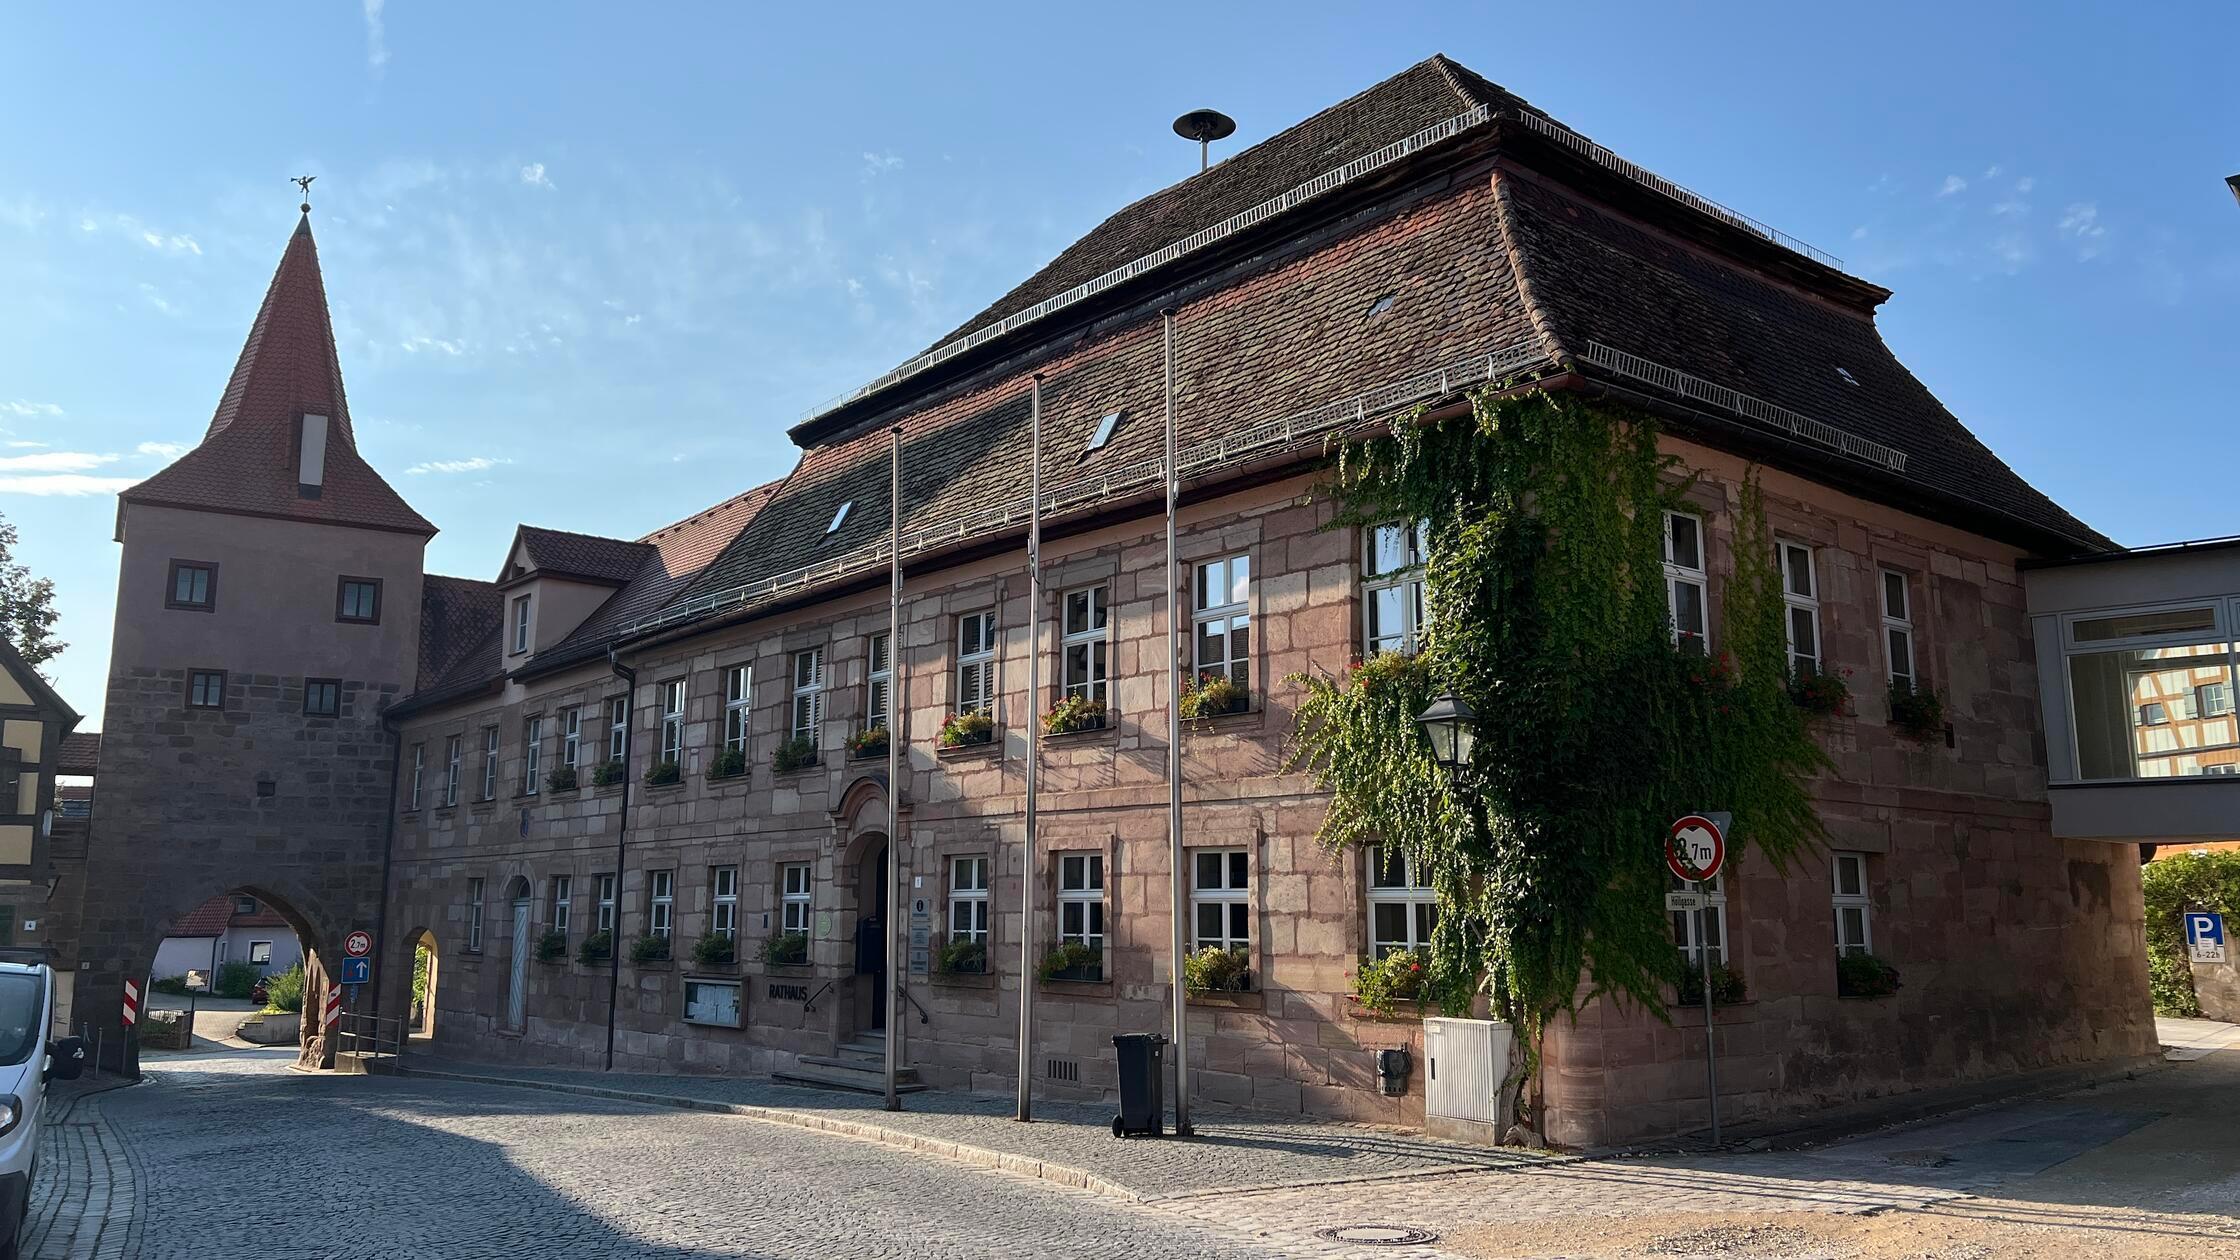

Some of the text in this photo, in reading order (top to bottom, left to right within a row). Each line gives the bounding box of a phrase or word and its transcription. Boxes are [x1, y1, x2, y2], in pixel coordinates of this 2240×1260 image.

[1677, 837, 1712, 861] 27m
[2193, 917, 2214, 939] P
[768, 983, 808, 1002] RATHAUS
